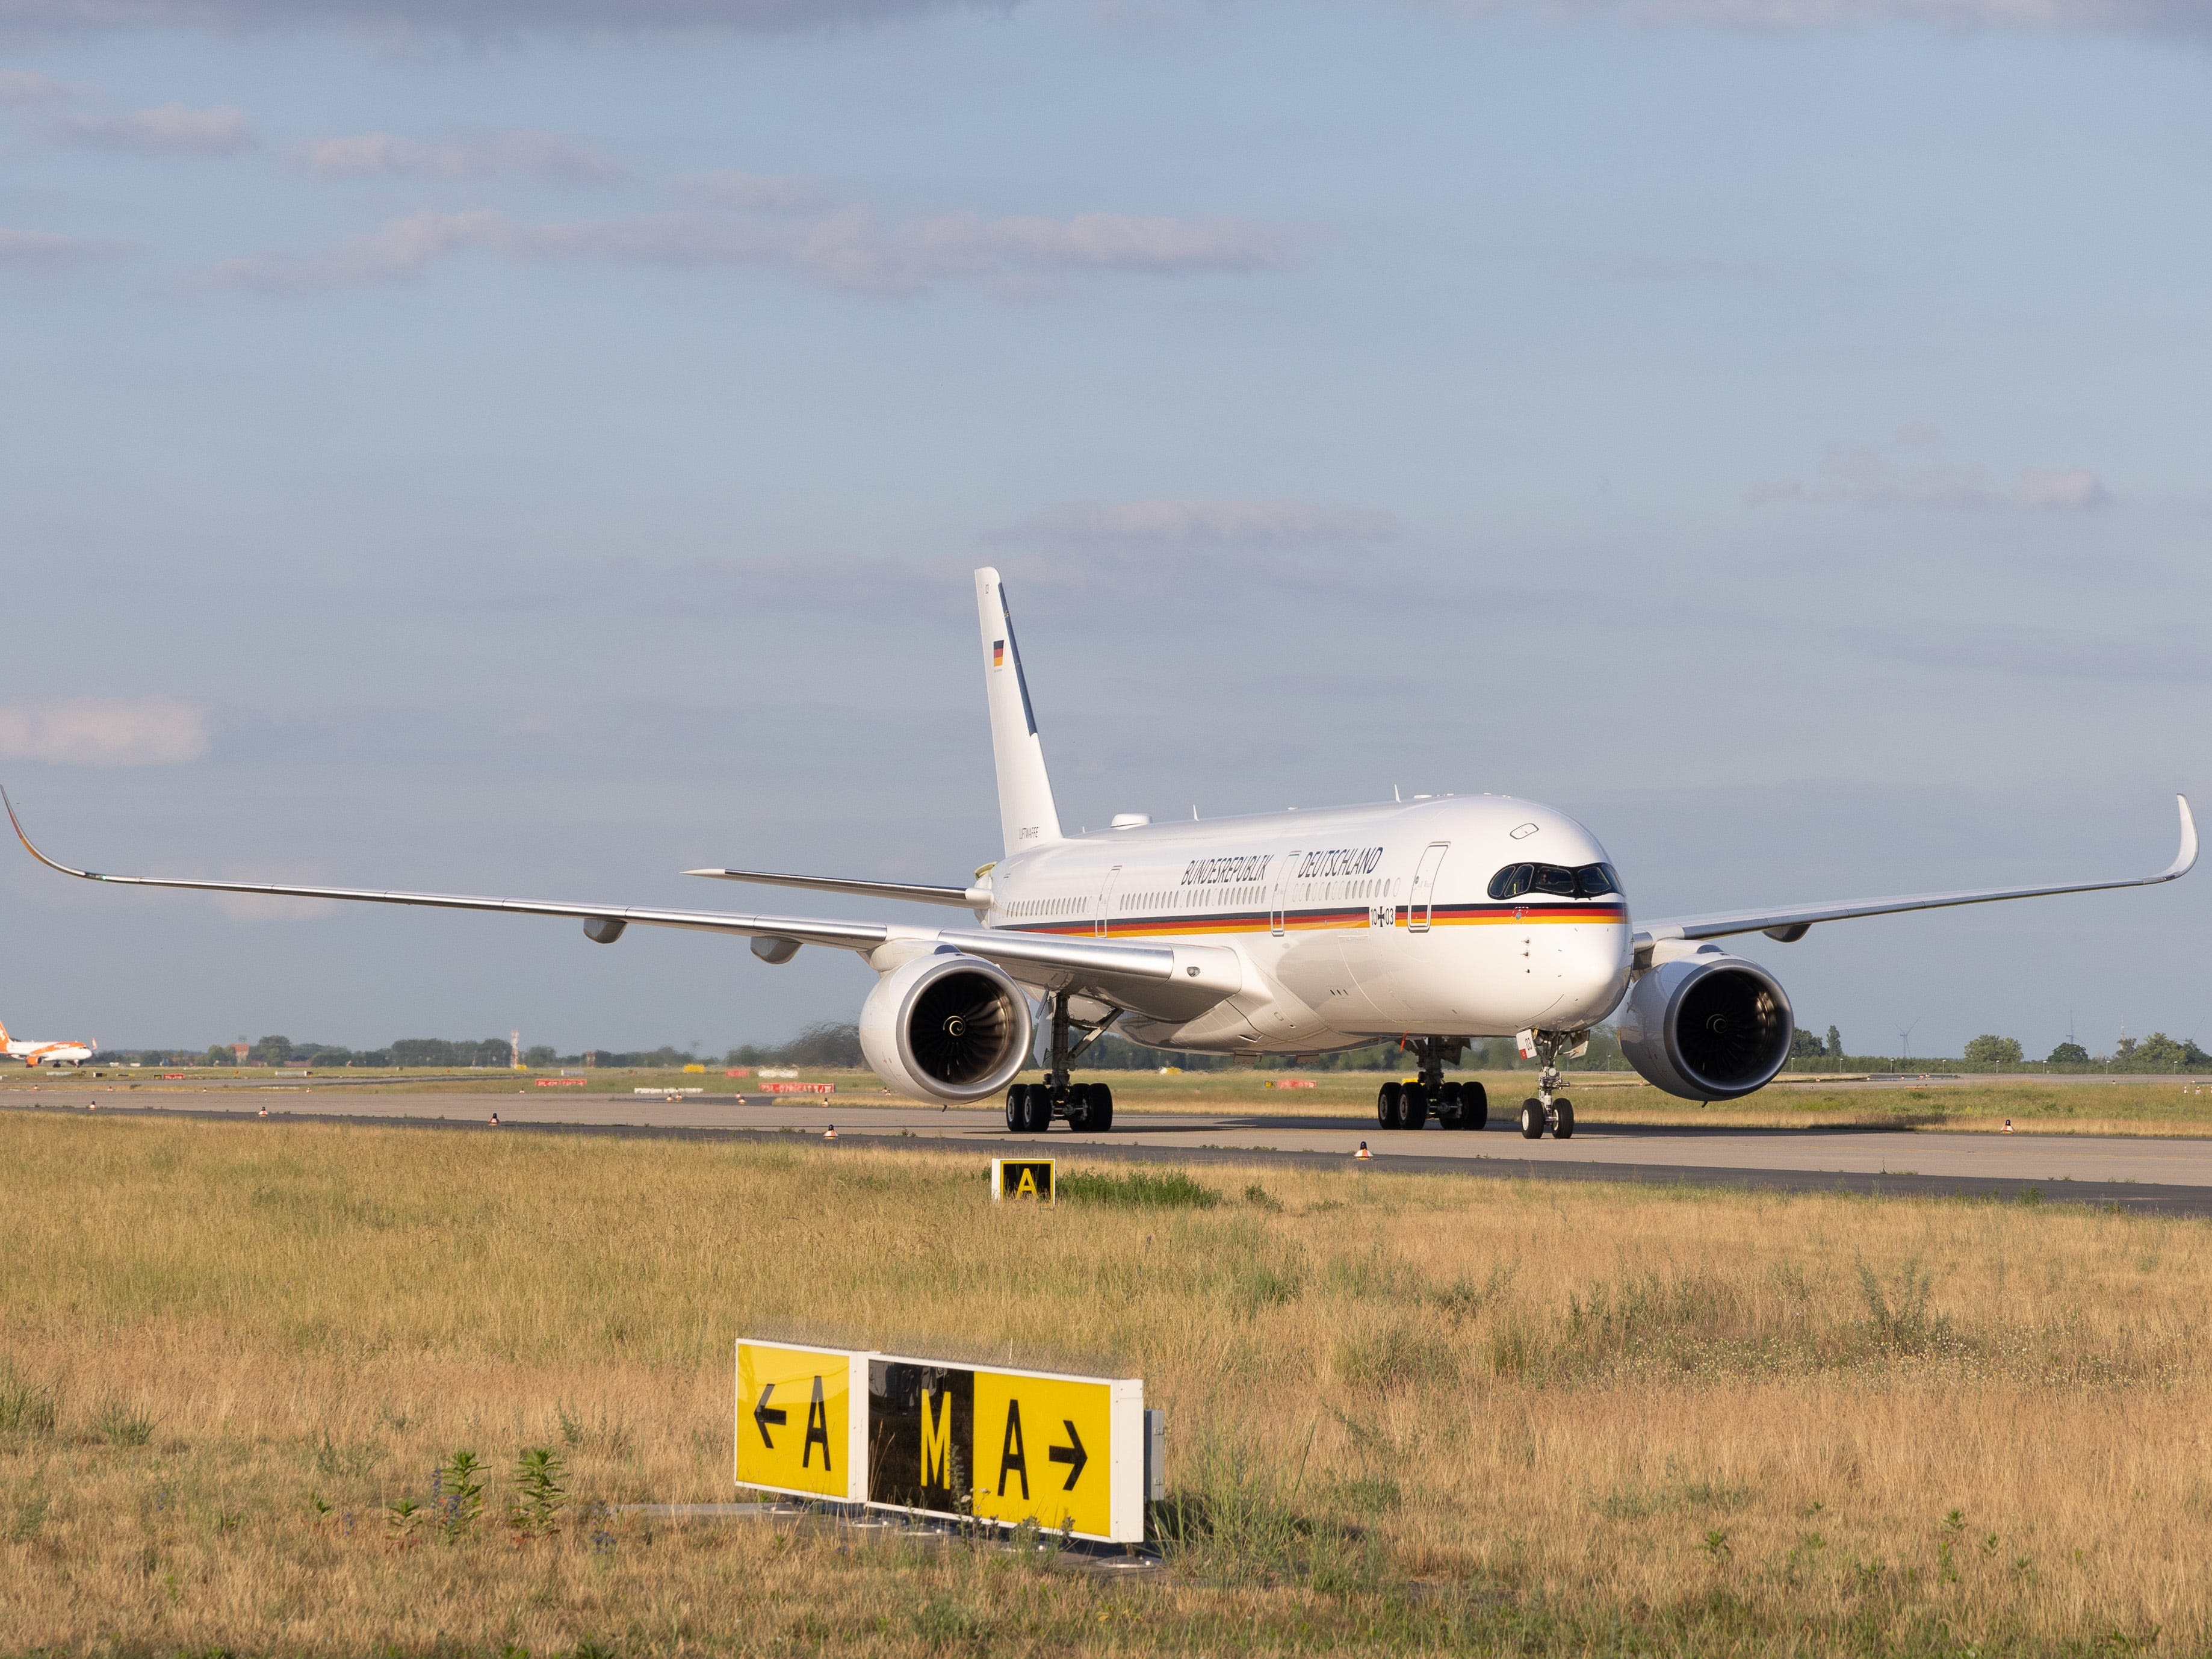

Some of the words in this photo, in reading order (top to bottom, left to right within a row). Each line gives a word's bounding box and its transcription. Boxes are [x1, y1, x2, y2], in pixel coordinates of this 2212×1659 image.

[1180, 854, 1275, 885] BUNDESREPUBLIK
[1297, 846, 1383, 878] DEUTSCHLAND
[1525, 1037, 1532, 1050] 03
[1015, 1168, 1039, 1201] A
[802, 1375, 831, 1472] A
[920, 1388, 952, 1490] M
[997, 1398, 1030, 1501] A
